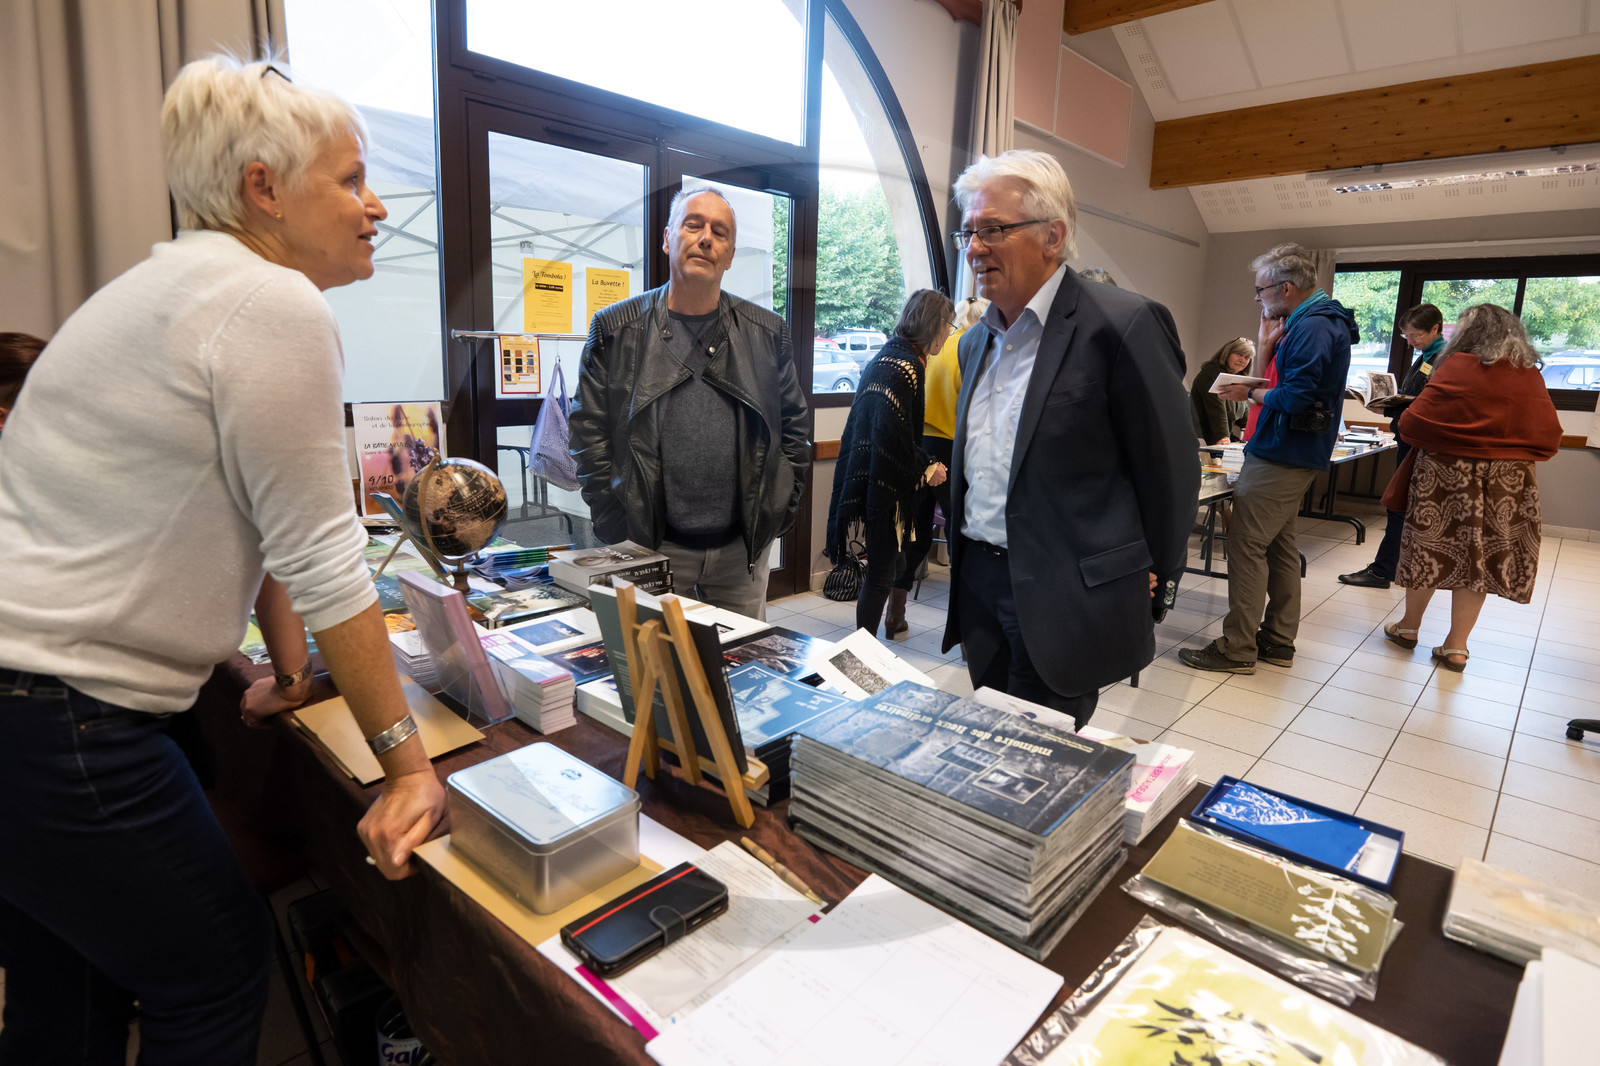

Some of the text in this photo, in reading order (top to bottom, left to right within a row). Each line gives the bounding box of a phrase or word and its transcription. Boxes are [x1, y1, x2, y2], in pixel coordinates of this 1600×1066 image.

[540, 271, 563, 281] Tombola
[600, 280, 621, 288] Buvette
[368, 474, 394, 485] 9/10
[874, 703, 933, 724] ordinaires
[935, 720, 968, 735] lieux
[970, 729, 993, 741] des
[994, 735, 1053, 757] mémoire
